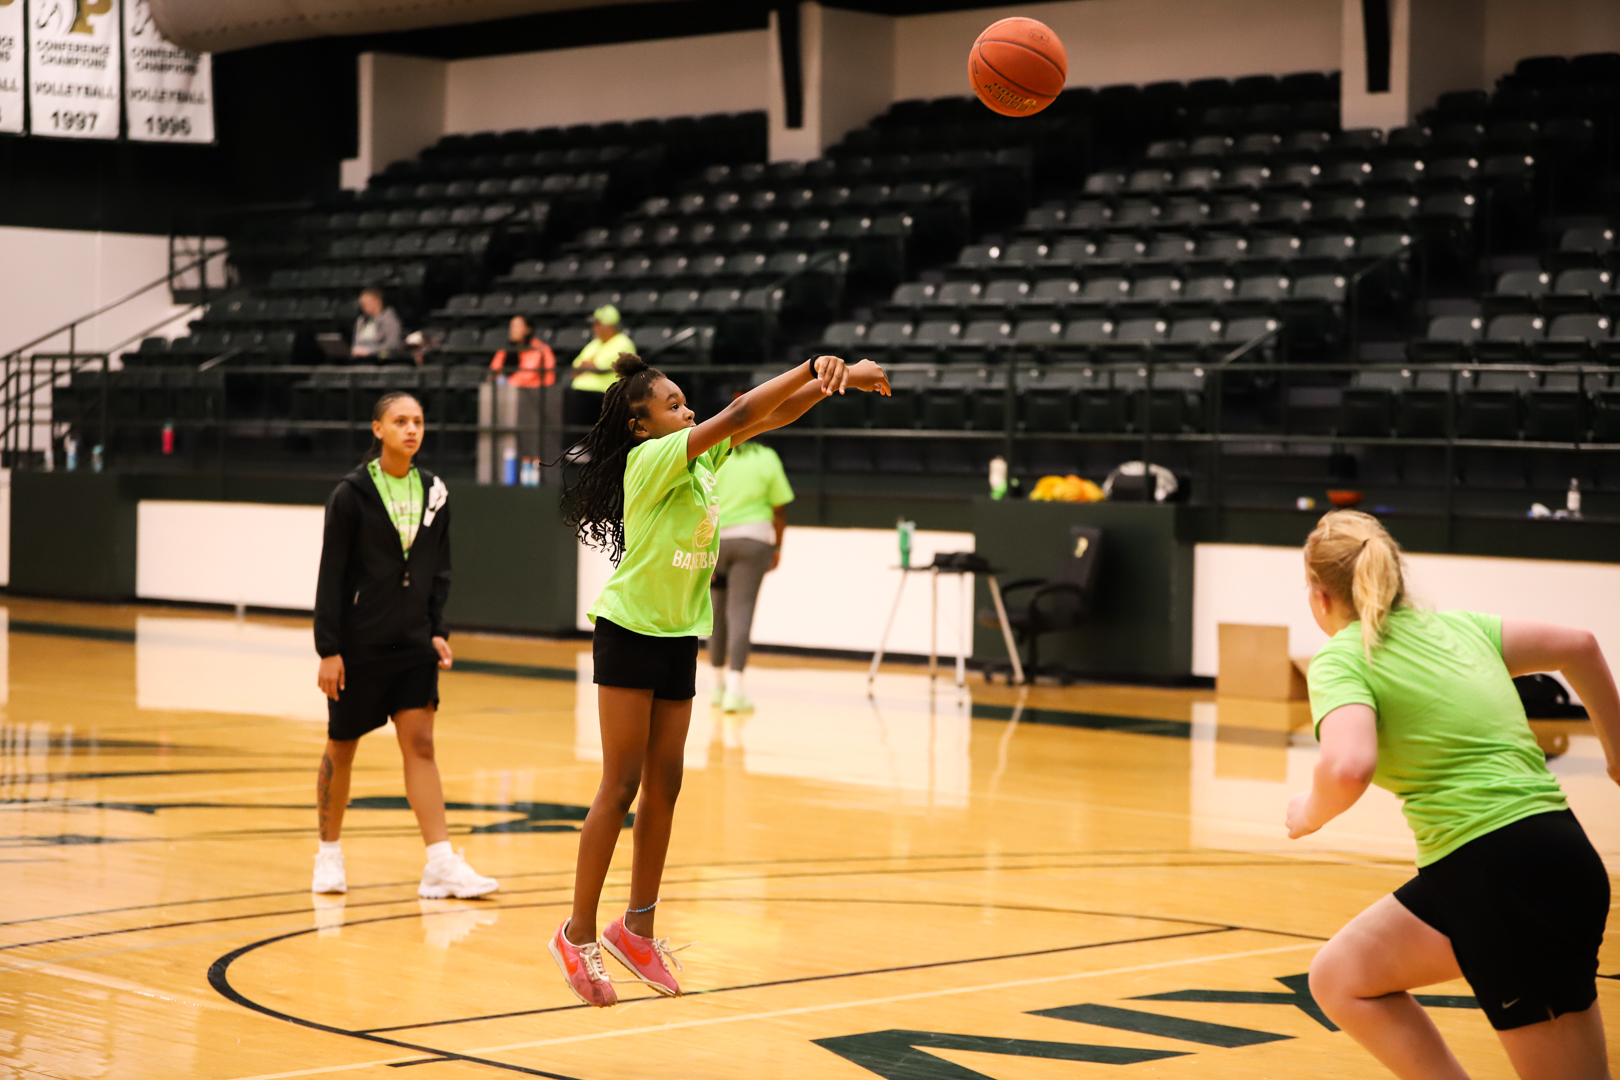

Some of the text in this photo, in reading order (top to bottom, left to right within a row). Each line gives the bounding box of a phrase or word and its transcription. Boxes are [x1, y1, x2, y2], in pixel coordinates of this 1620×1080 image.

[37, 40, 109, 57] CONFERENCE
[41, 54, 107, 70] CHAMPIONS
[35, 80, 115, 99] VOLLEYBALL
[129, 87, 206, 104] VOLLEYBALL
[52, 109, 98, 130] 1997
[146, 115, 192, 136] 1996
